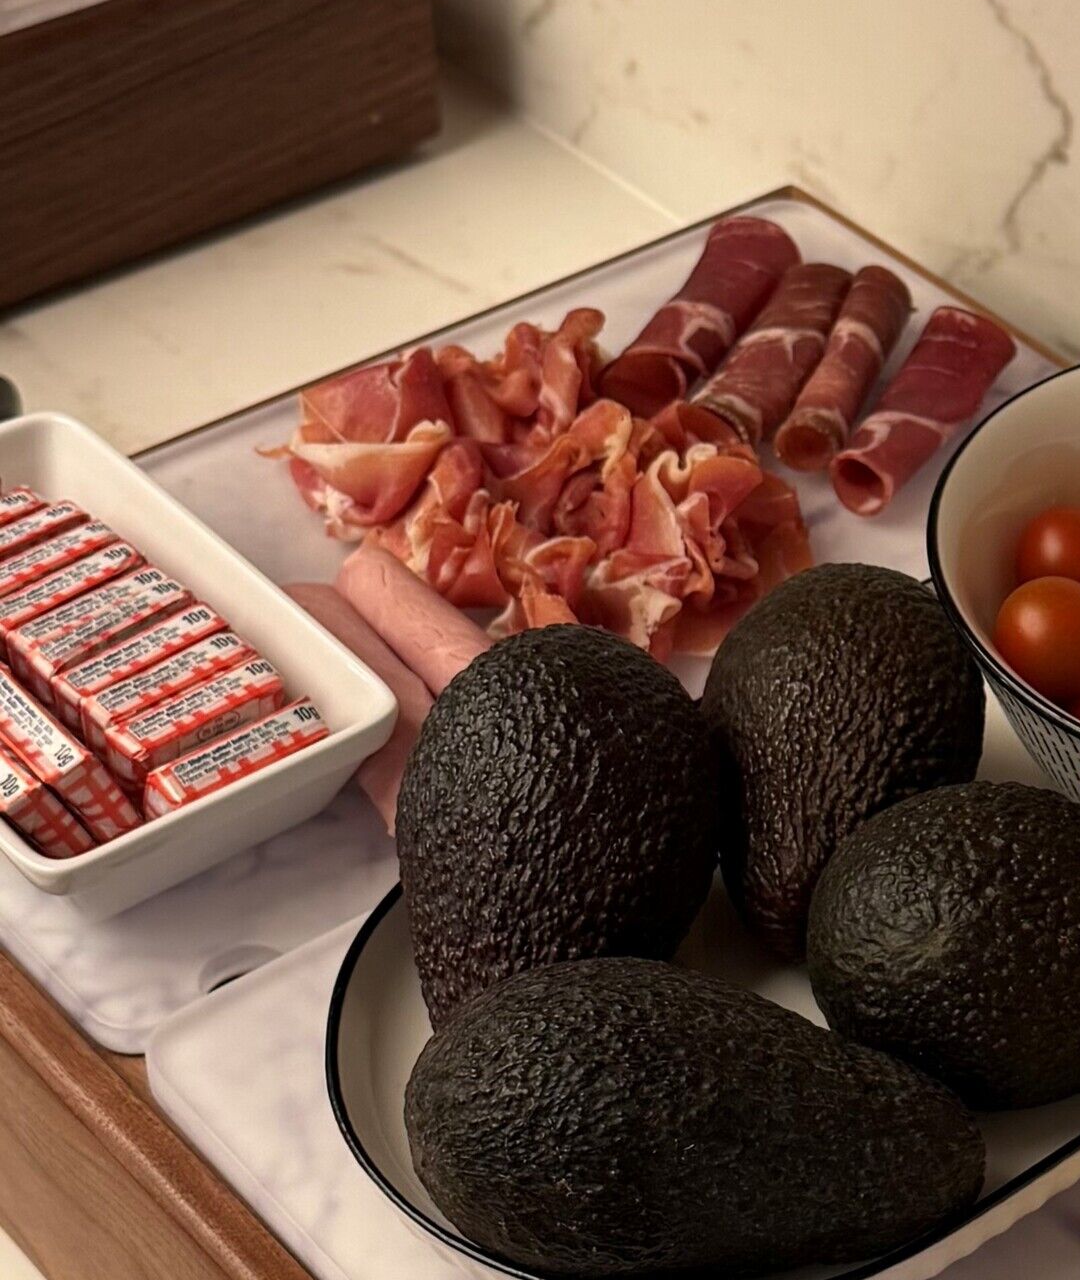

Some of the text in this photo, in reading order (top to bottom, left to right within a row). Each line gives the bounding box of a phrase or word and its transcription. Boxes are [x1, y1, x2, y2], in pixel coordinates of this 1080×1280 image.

[182, 609, 211, 625] 10g
[210, 636, 239, 650] 10g
[245, 662, 273, 676] 10g
[293, 706, 321, 721] 10g
[54, 744, 75, 768] 10g
